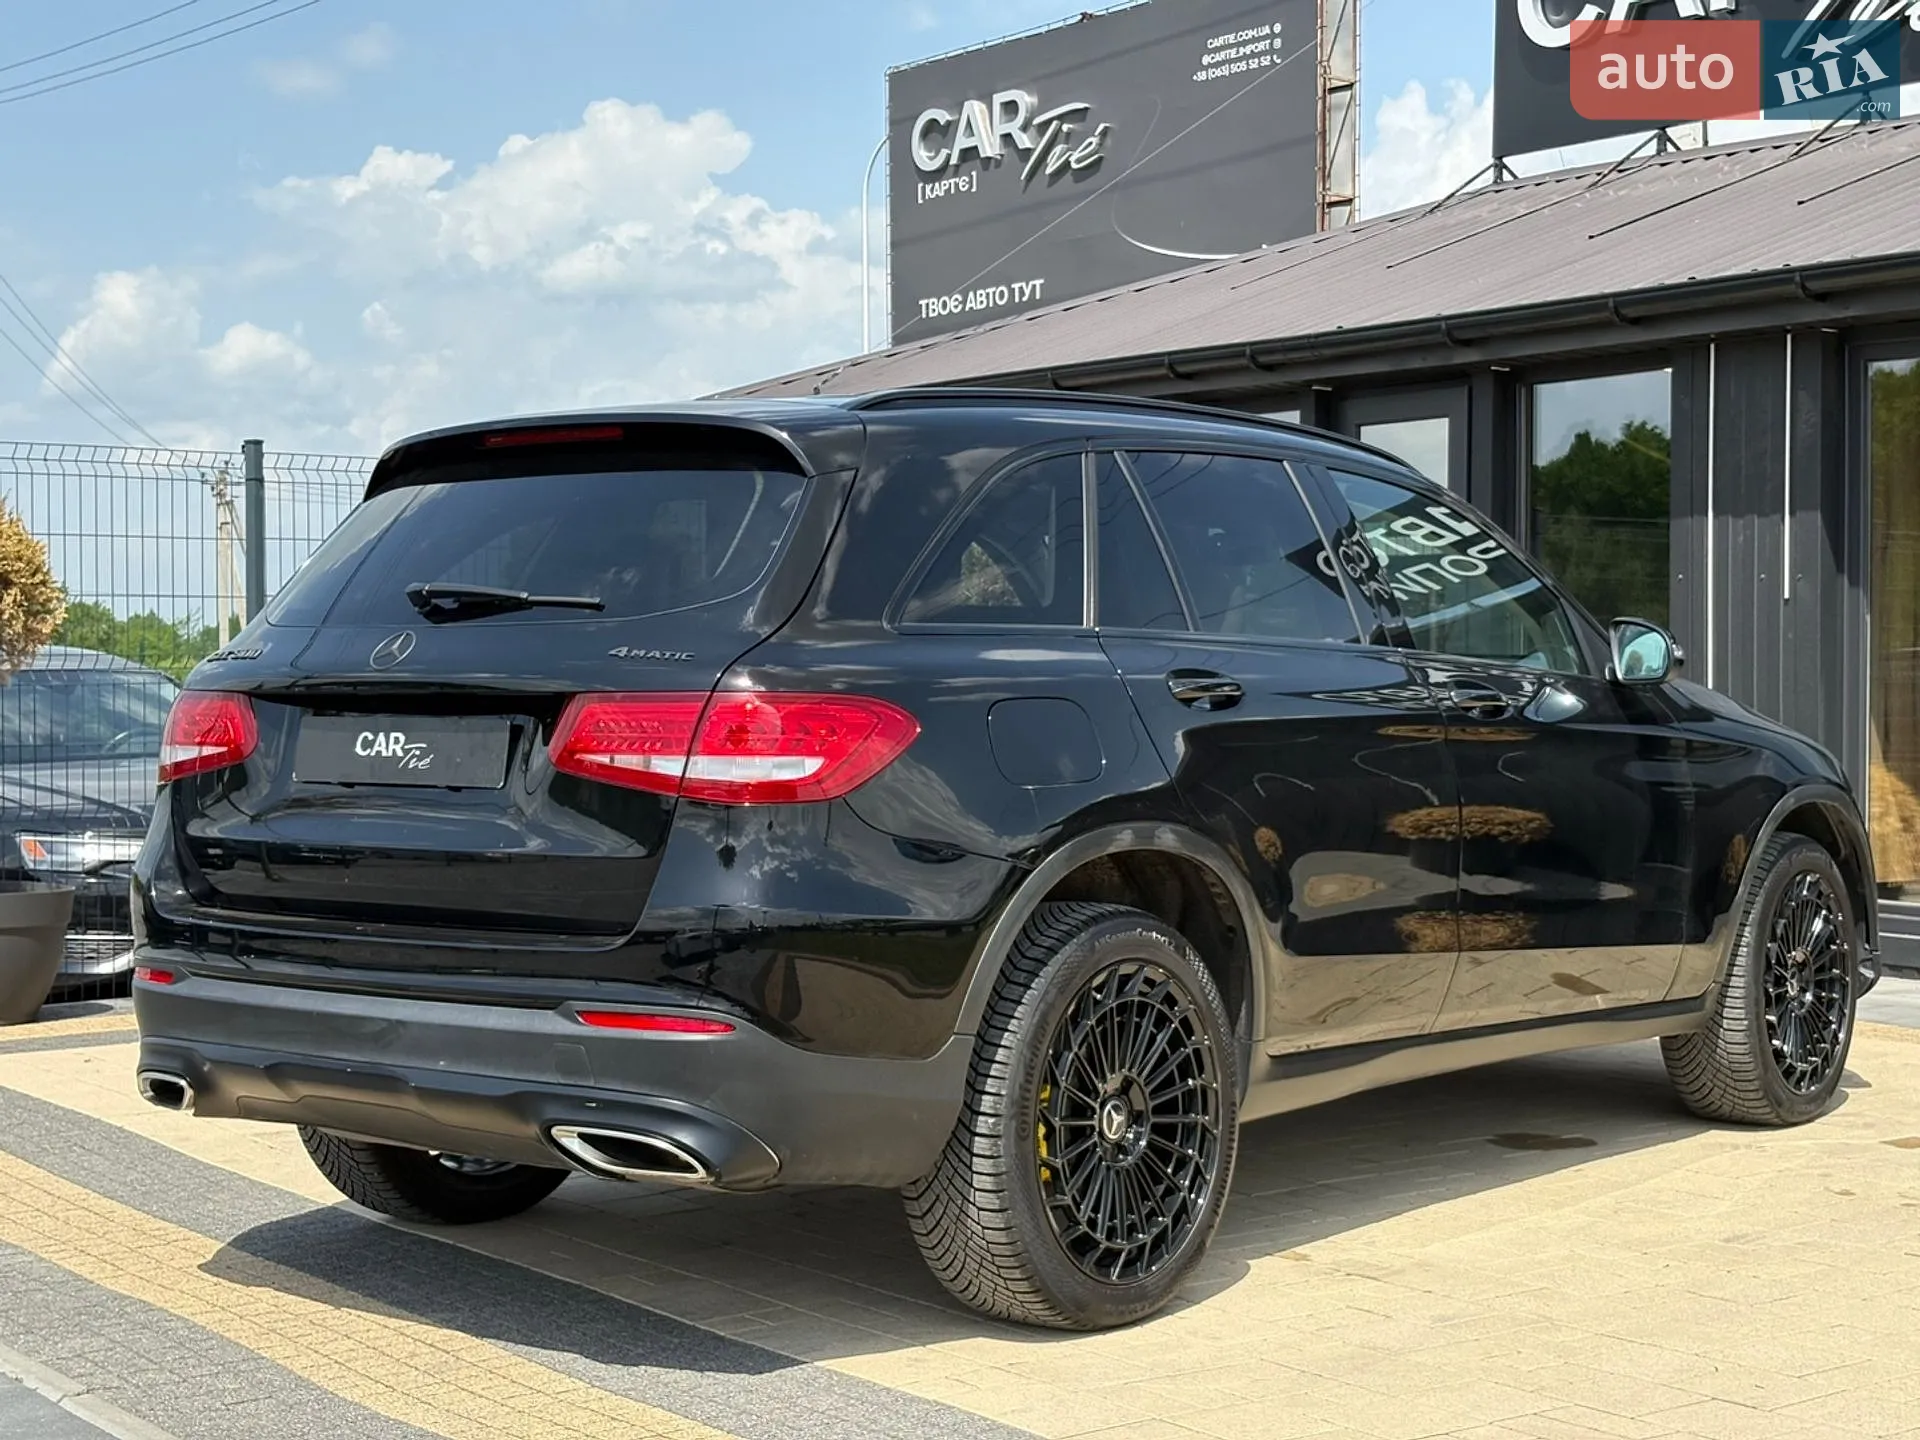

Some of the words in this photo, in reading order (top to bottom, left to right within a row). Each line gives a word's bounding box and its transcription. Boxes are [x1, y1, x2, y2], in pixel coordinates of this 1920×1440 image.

[911, 89, 1036, 172] CAR
[919, 294, 963, 319] ТВОЄ
[965, 285, 1008, 312] АВТО
[1011, 279, 1045, 303] ТУТ
[608, 646, 695, 661] 4MATIC
[355, 731, 406, 757] CAR
